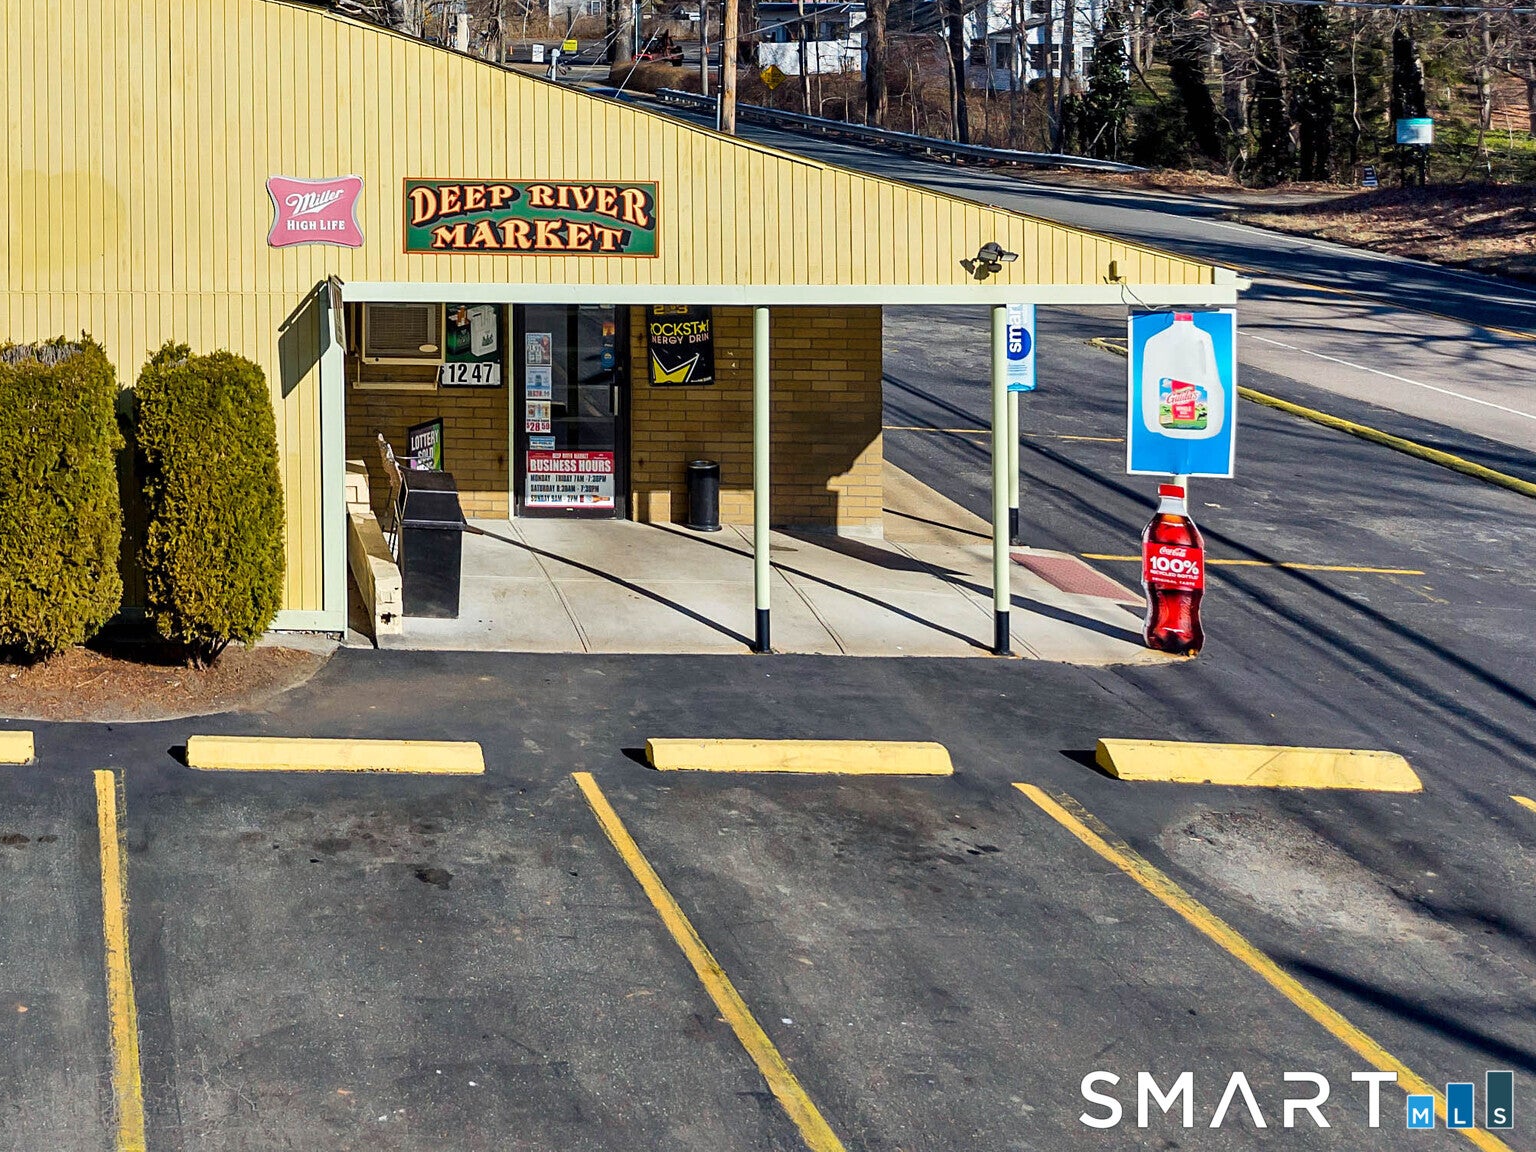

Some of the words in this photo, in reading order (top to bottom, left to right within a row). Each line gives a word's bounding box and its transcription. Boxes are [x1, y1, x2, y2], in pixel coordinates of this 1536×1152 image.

[285, 189, 344, 215] Miller
[408, 183, 516, 225] DEEP
[526, 184, 650, 227] RIVER
[286, 220, 317, 230] HIGH
[319, 220, 345, 230] LIFE
[431, 219, 625, 251] MARKET
[411, 429, 440, 451] LOTTERY
[530, 459, 577, 472] BUSINESS
[578, 459, 611, 472] HOURS
[530, 484, 555, 493] SATURDAY
[1150, 556, 1199, 574] 100%
